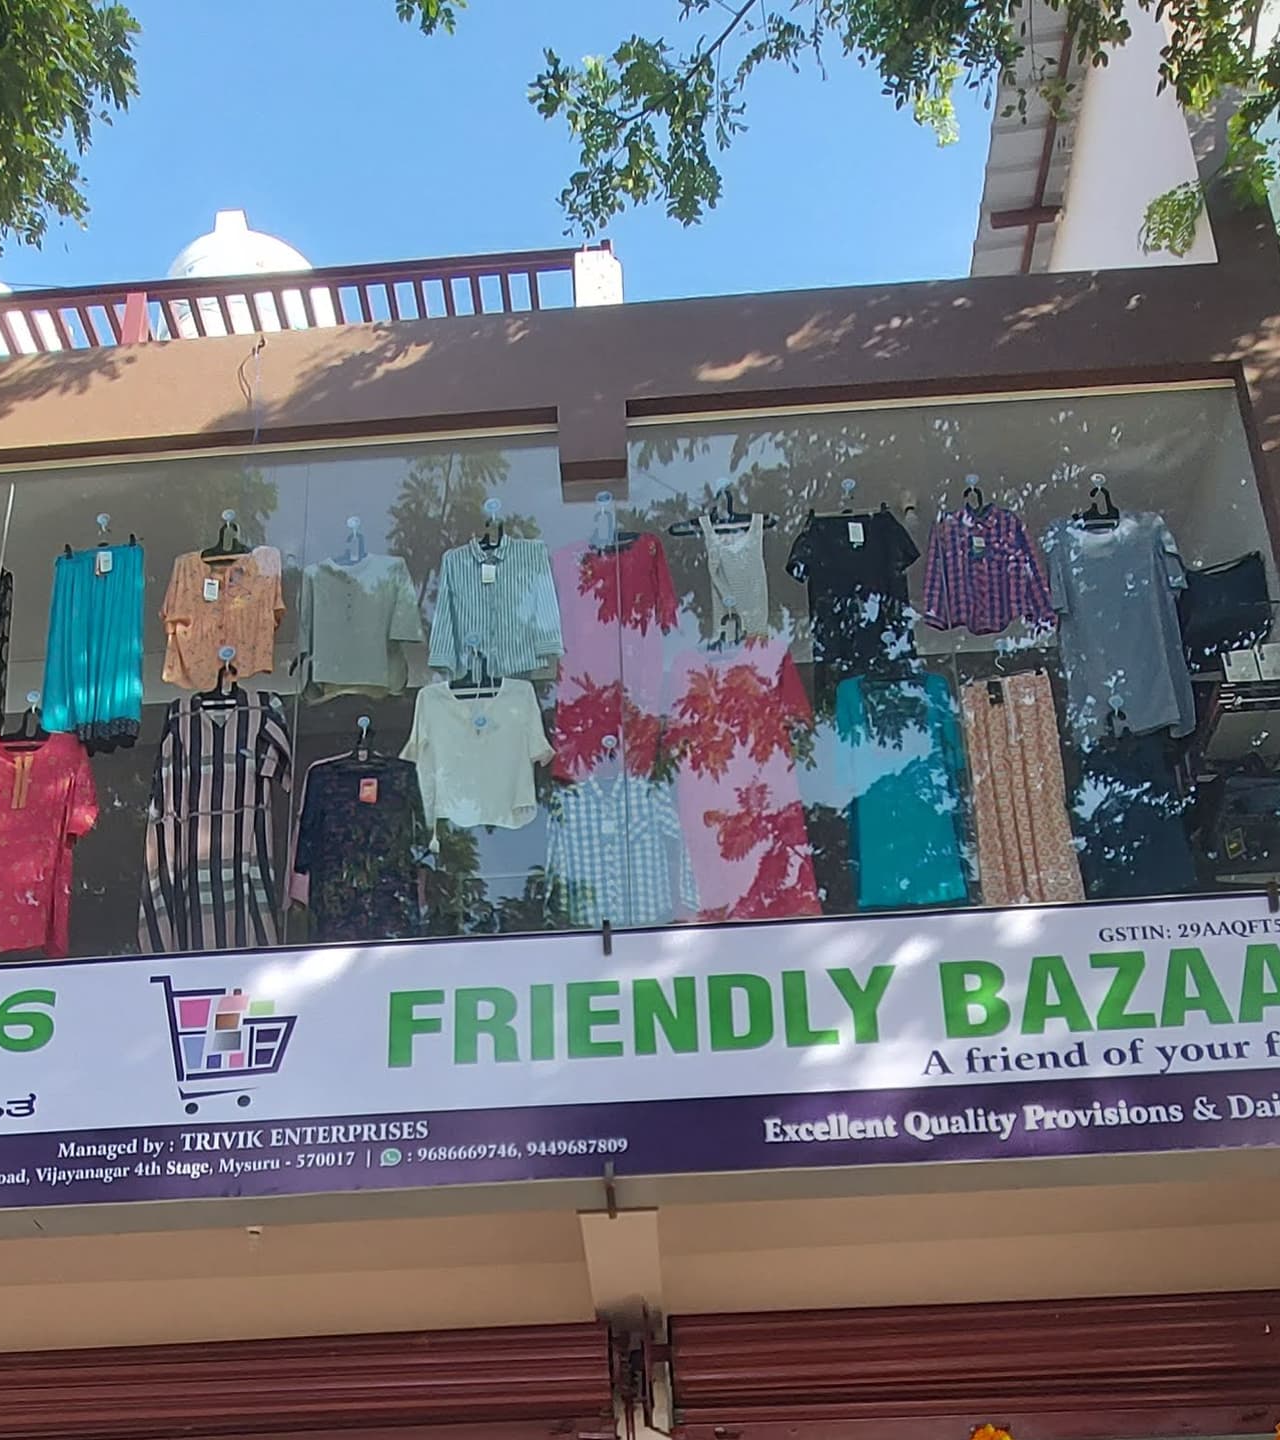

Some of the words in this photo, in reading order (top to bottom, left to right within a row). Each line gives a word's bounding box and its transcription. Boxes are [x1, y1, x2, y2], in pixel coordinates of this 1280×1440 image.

[1098, 923, 1172, 944] GSTIN:
[386, 965, 897, 1068] FRIENDLY
[922, 1050, 953, 1076] A
[965, 1041, 1088, 1075] friend
[1102, 1038, 1146, 1069] of
[1158, 1036, 1251, 1074] your
[58, 1140, 139, 1163] Managed
[143, 1137, 166, 1161] by
[180, 1130, 265, 1154] TRIVIK
[269, 1120, 429, 1148] ENTERPRISES
[763, 1109, 898, 1145] Excellent
[904, 1106, 1017, 1142] Quality
[1023, 1099, 1185, 1132] Provisions
[1193, 1095, 1223, 1121] &
[35, 1162, 131, 1188] Vijayanagar
[133, 1161, 162, 1180] 4th
[166, 1158, 214, 1182] Stage,
[218, 1154, 281, 1179] Mysuru
[296, 1150, 355, 1171] 570017
[417, 1142, 522, 1167] 9686669746,
[527, 1136, 629, 1158] 9449687809
